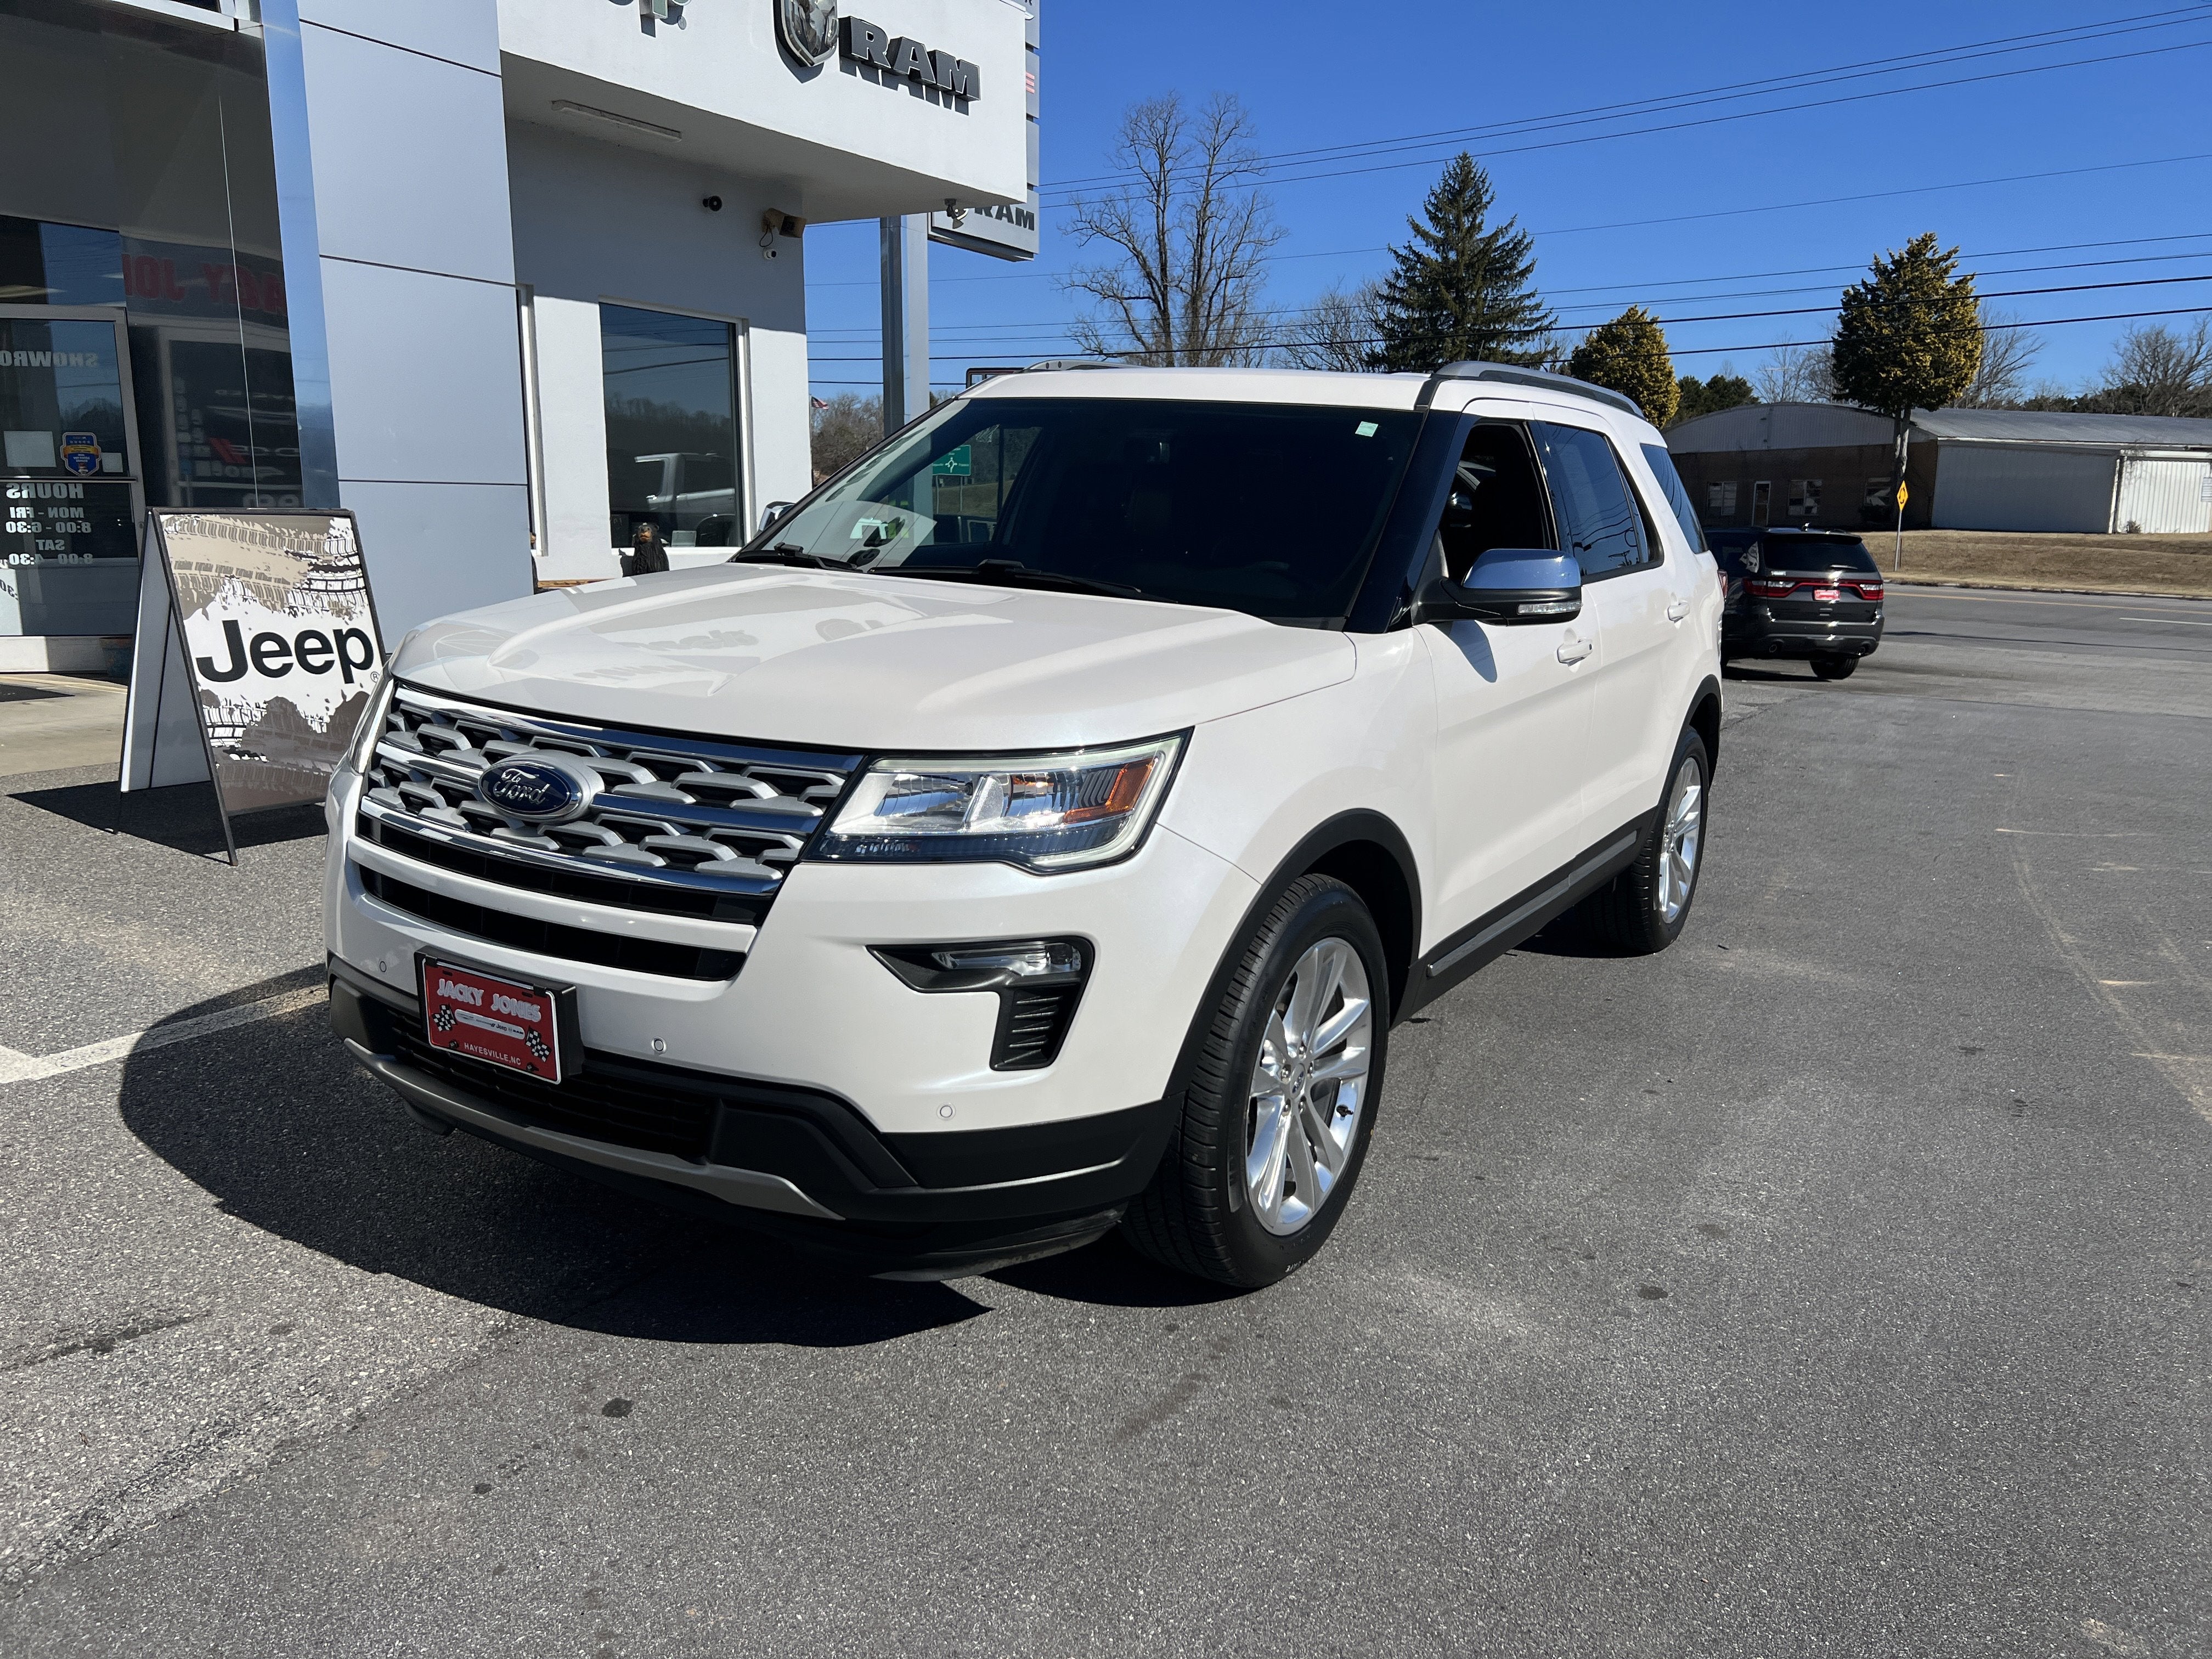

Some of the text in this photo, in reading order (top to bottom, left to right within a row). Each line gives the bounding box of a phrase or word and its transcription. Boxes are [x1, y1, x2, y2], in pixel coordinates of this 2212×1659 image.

[844, 15, 981, 101] RAM
[195, 619, 374, 684] Jeep
[493, 768, 551, 804] Ford
[437, 978, 542, 1023] JACKY JONES
[464, 1042, 521, 1065] HAYESVILLE,NC
